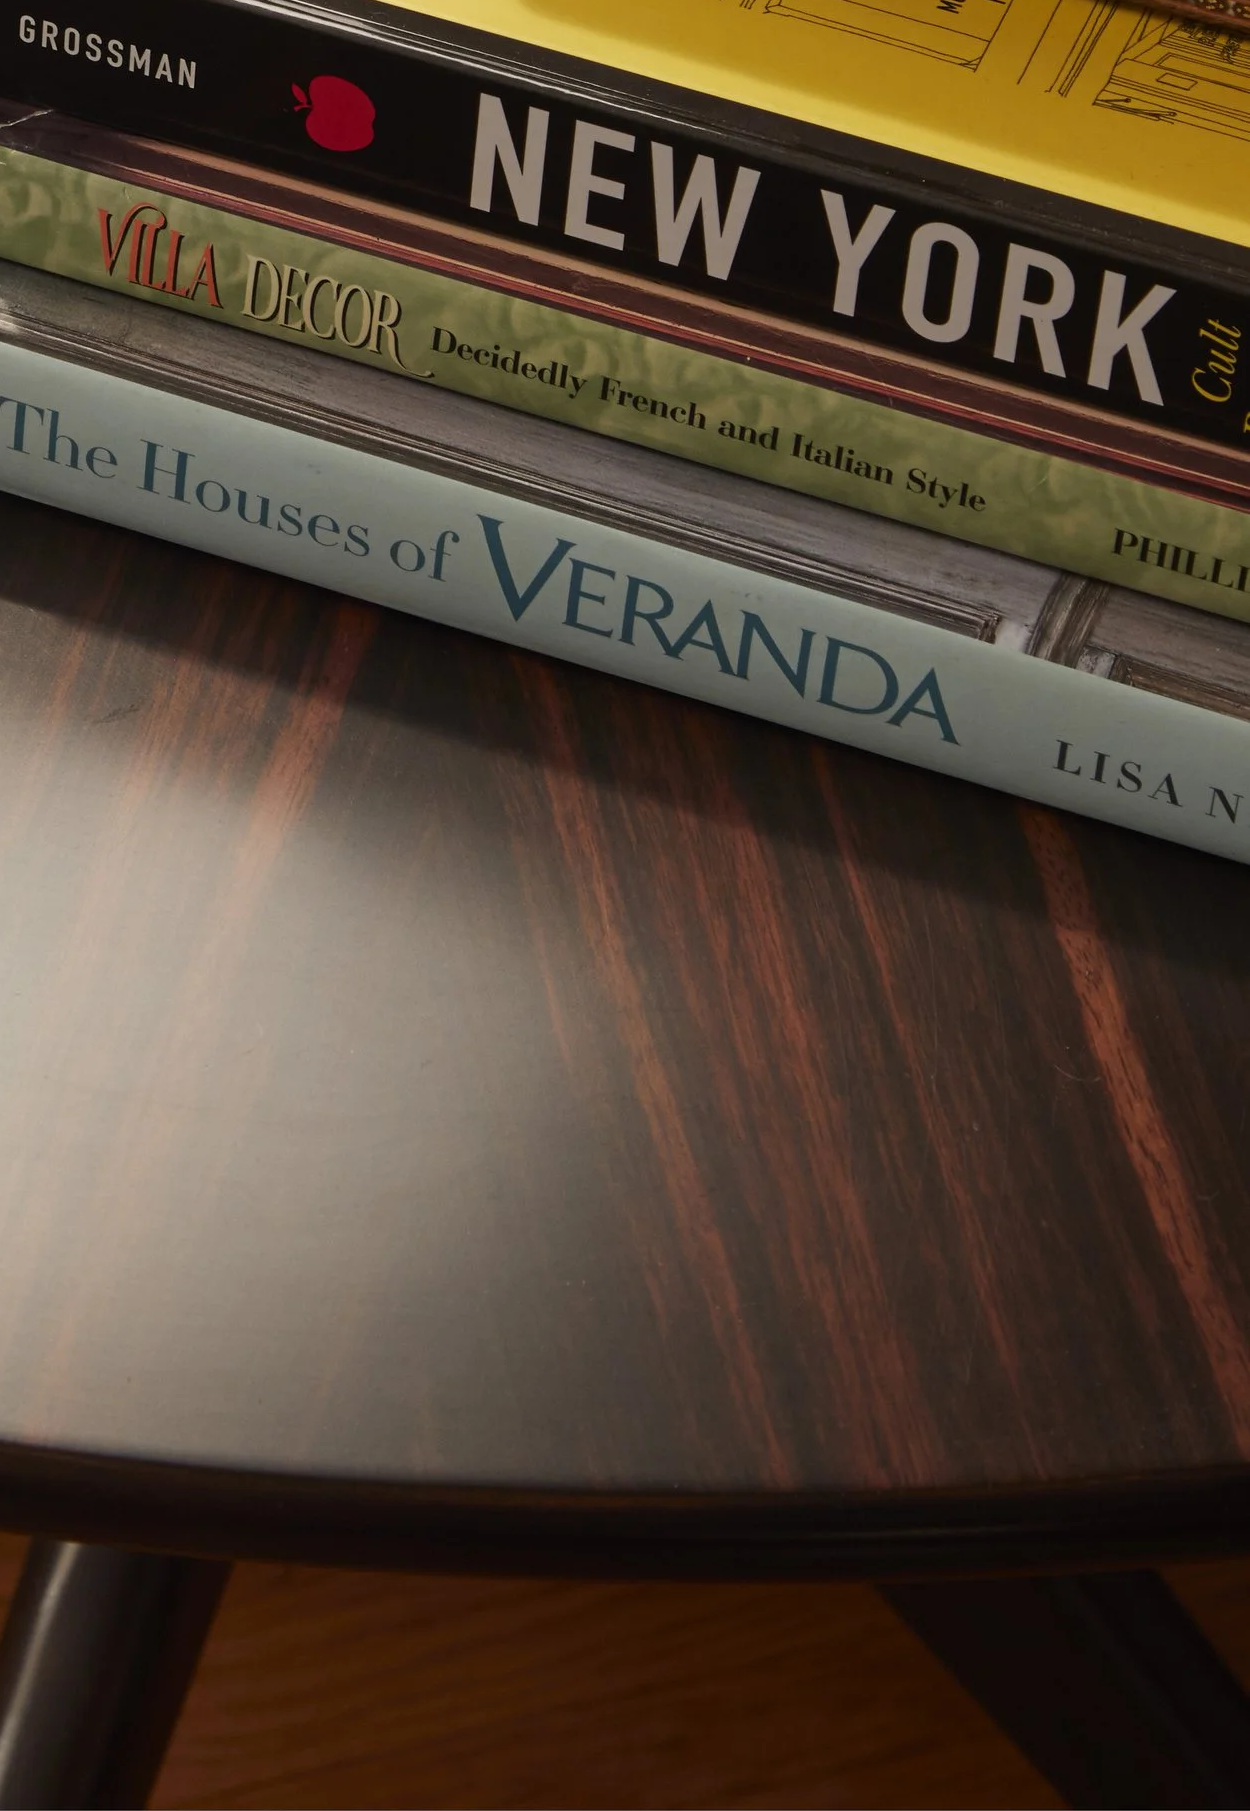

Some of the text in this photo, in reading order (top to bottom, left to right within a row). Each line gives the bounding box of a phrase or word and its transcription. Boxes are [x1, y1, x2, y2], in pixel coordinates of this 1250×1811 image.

[18, 14, 198, 89] GROSSMAN
[97, 201, 435, 378] VILLA DECOR
[469, 92, 1177, 407] NEW YORK
[431, 326, 987, 513] Decidedly French and Italian Style
[1191, 317, 1242, 403] Cult
[136, 438, 371, 558] Houses
[389, 530, 460, 583] of
[476, 514, 961, 747] VERANDA
[1053, 739, 1183, 807] LISA
